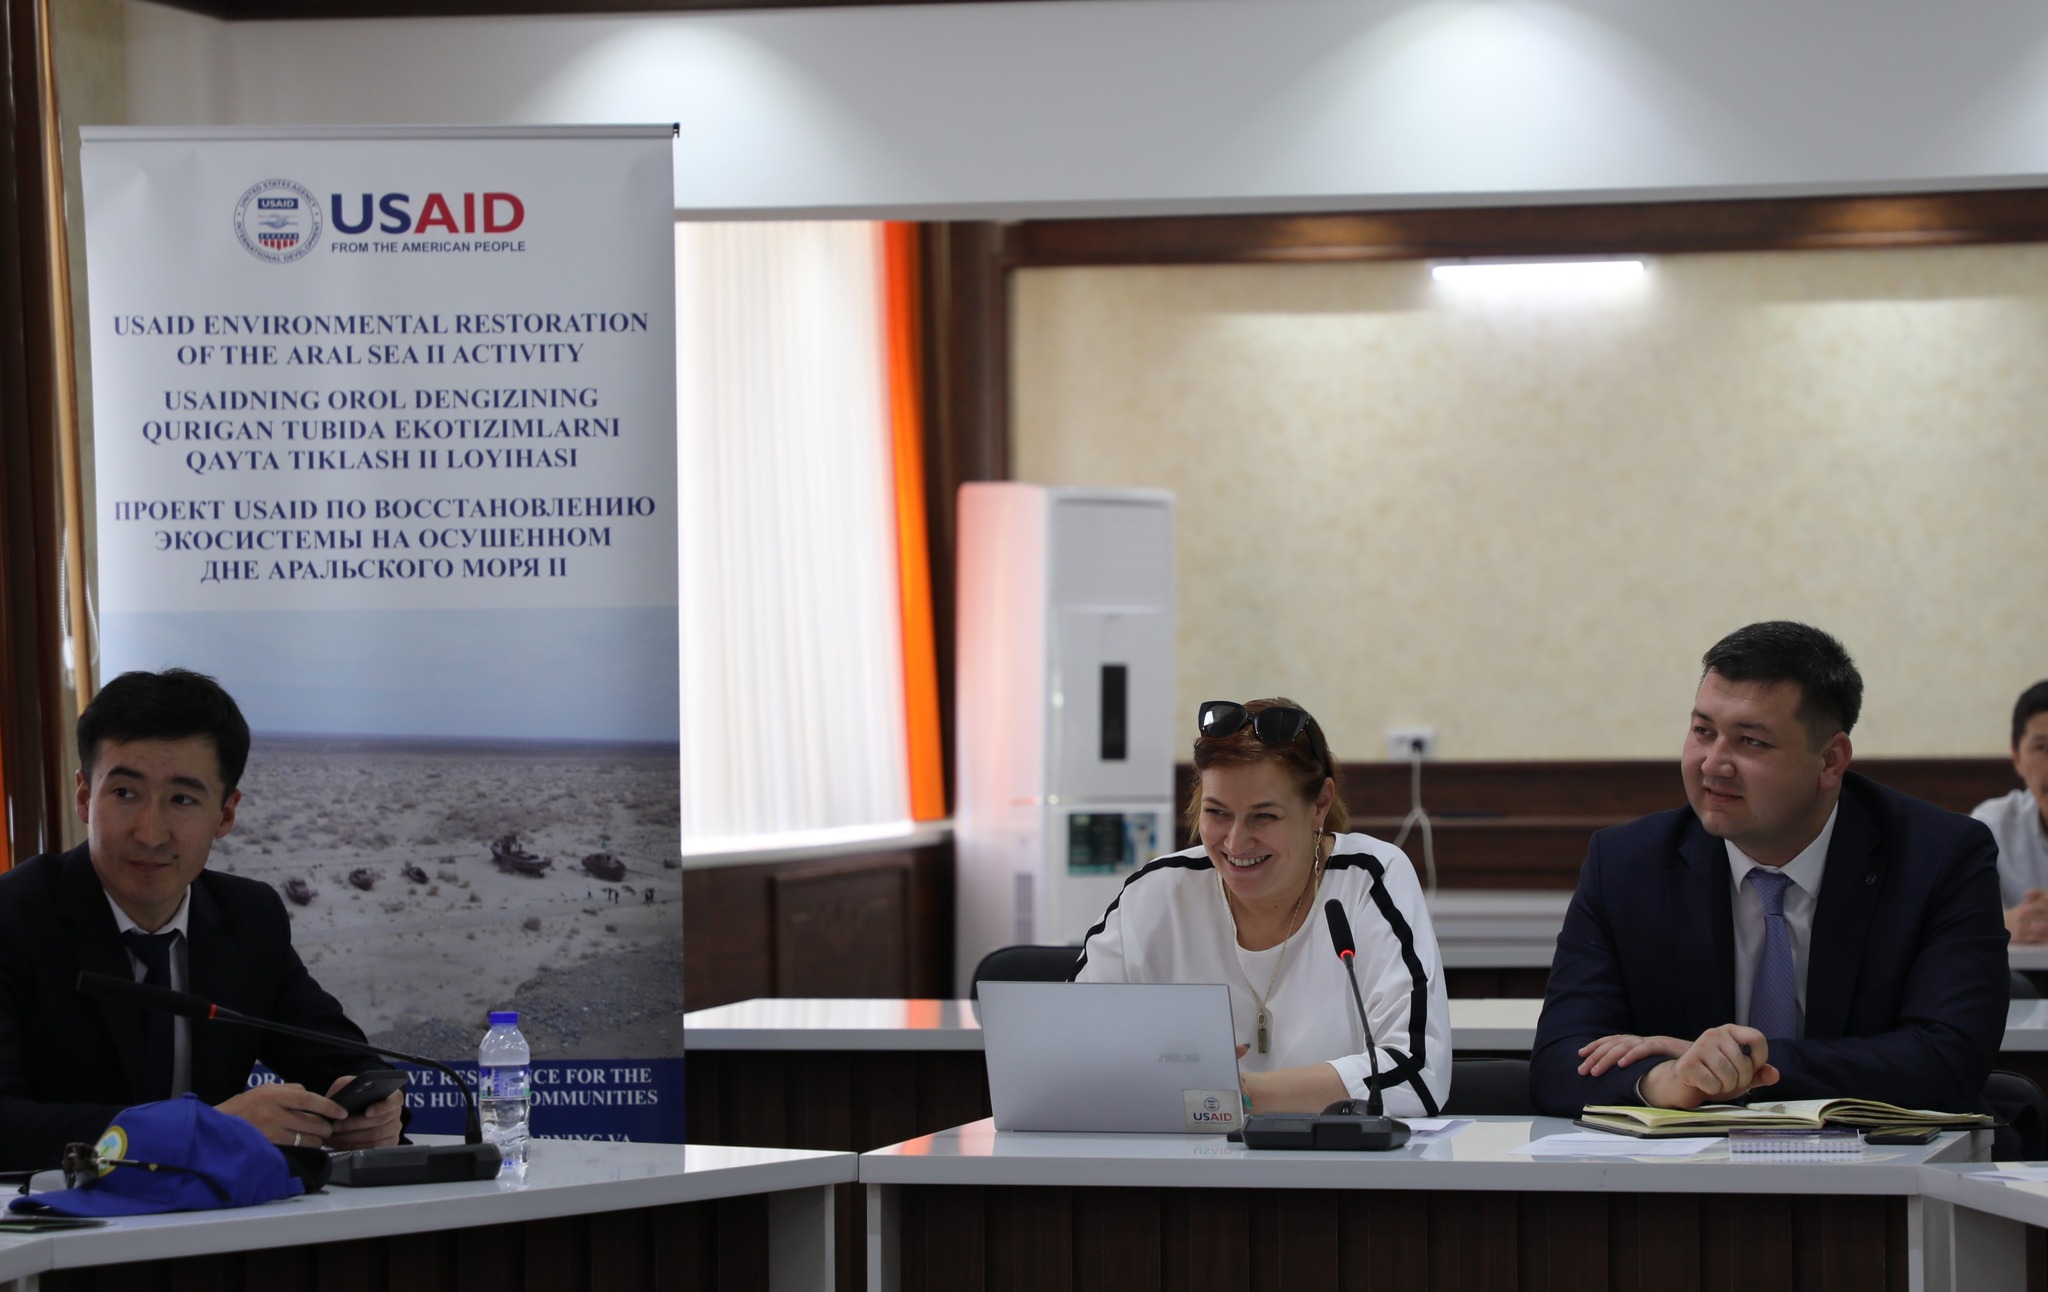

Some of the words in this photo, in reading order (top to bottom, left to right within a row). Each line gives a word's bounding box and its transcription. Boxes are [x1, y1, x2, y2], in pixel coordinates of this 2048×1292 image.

[262, 200, 295, 209] USAID
[330, 192, 525, 235] USAID
[331, 242, 369, 253] FROM
[373, 242, 398, 253] THE
[401, 241, 471, 253] AMERICAN
[475, 240, 526, 252] PEOPLE
[114, 315, 195, 336] USAID
[204, 314, 448, 335] ENVIRONMENTAL
[455, 312, 648, 334] RESTORATION
[176, 345, 215, 365] OF
[220, 345, 278, 365] THE
[287, 345, 362, 365] ARAL
[368, 344, 419, 364] SEA
[427, 344, 445, 364] II
[452, 343, 584, 364] ACTIVITY
[165, 390, 319, 411] USAIDNING
[328, 389, 406, 410] OROL
[415, 387, 598, 409] DENGIZINING
[142, 420, 273, 445] QURIGAN
[281, 420, 386, 440] TUBIDA
[395, 417, 619, 440] EKOTIZIMLARNI
[186, 450, 280, 475] QAYTA
[288, 449, 409, 470] TIKLASH
[419, 449, 437, 470] II
[447, 448, 577, 469] LOYIHASI
[115, 500, 225, 521] ПРОЕКТ
[234, 500, 318, 520] USAID
[327, 499, 367, 520] ПО
[375, 496, 656, 519] ВОССТАНОВЛЕНИЮ
[155, 528, 362, 550] ЭКОСИСТЕМЫ
[372, 529, 410, 549] НА
[418, 527, 611, 548] ОСУШЕННОМ
[200, 560, 259, 583] ДНЕ
[268, 558, 454, 580] АРАЛЬСКОГО
[463, 557, 539, 578] МОРЯ
[549, 557, 566, 577] II
[566, 1069, 606, 1085] FOR
[611, 1068, 652, 1084] THE
[529, 1089, 658, 1106] OMMUNITIES
[1193, 1112, 1233, 1122] USAID
